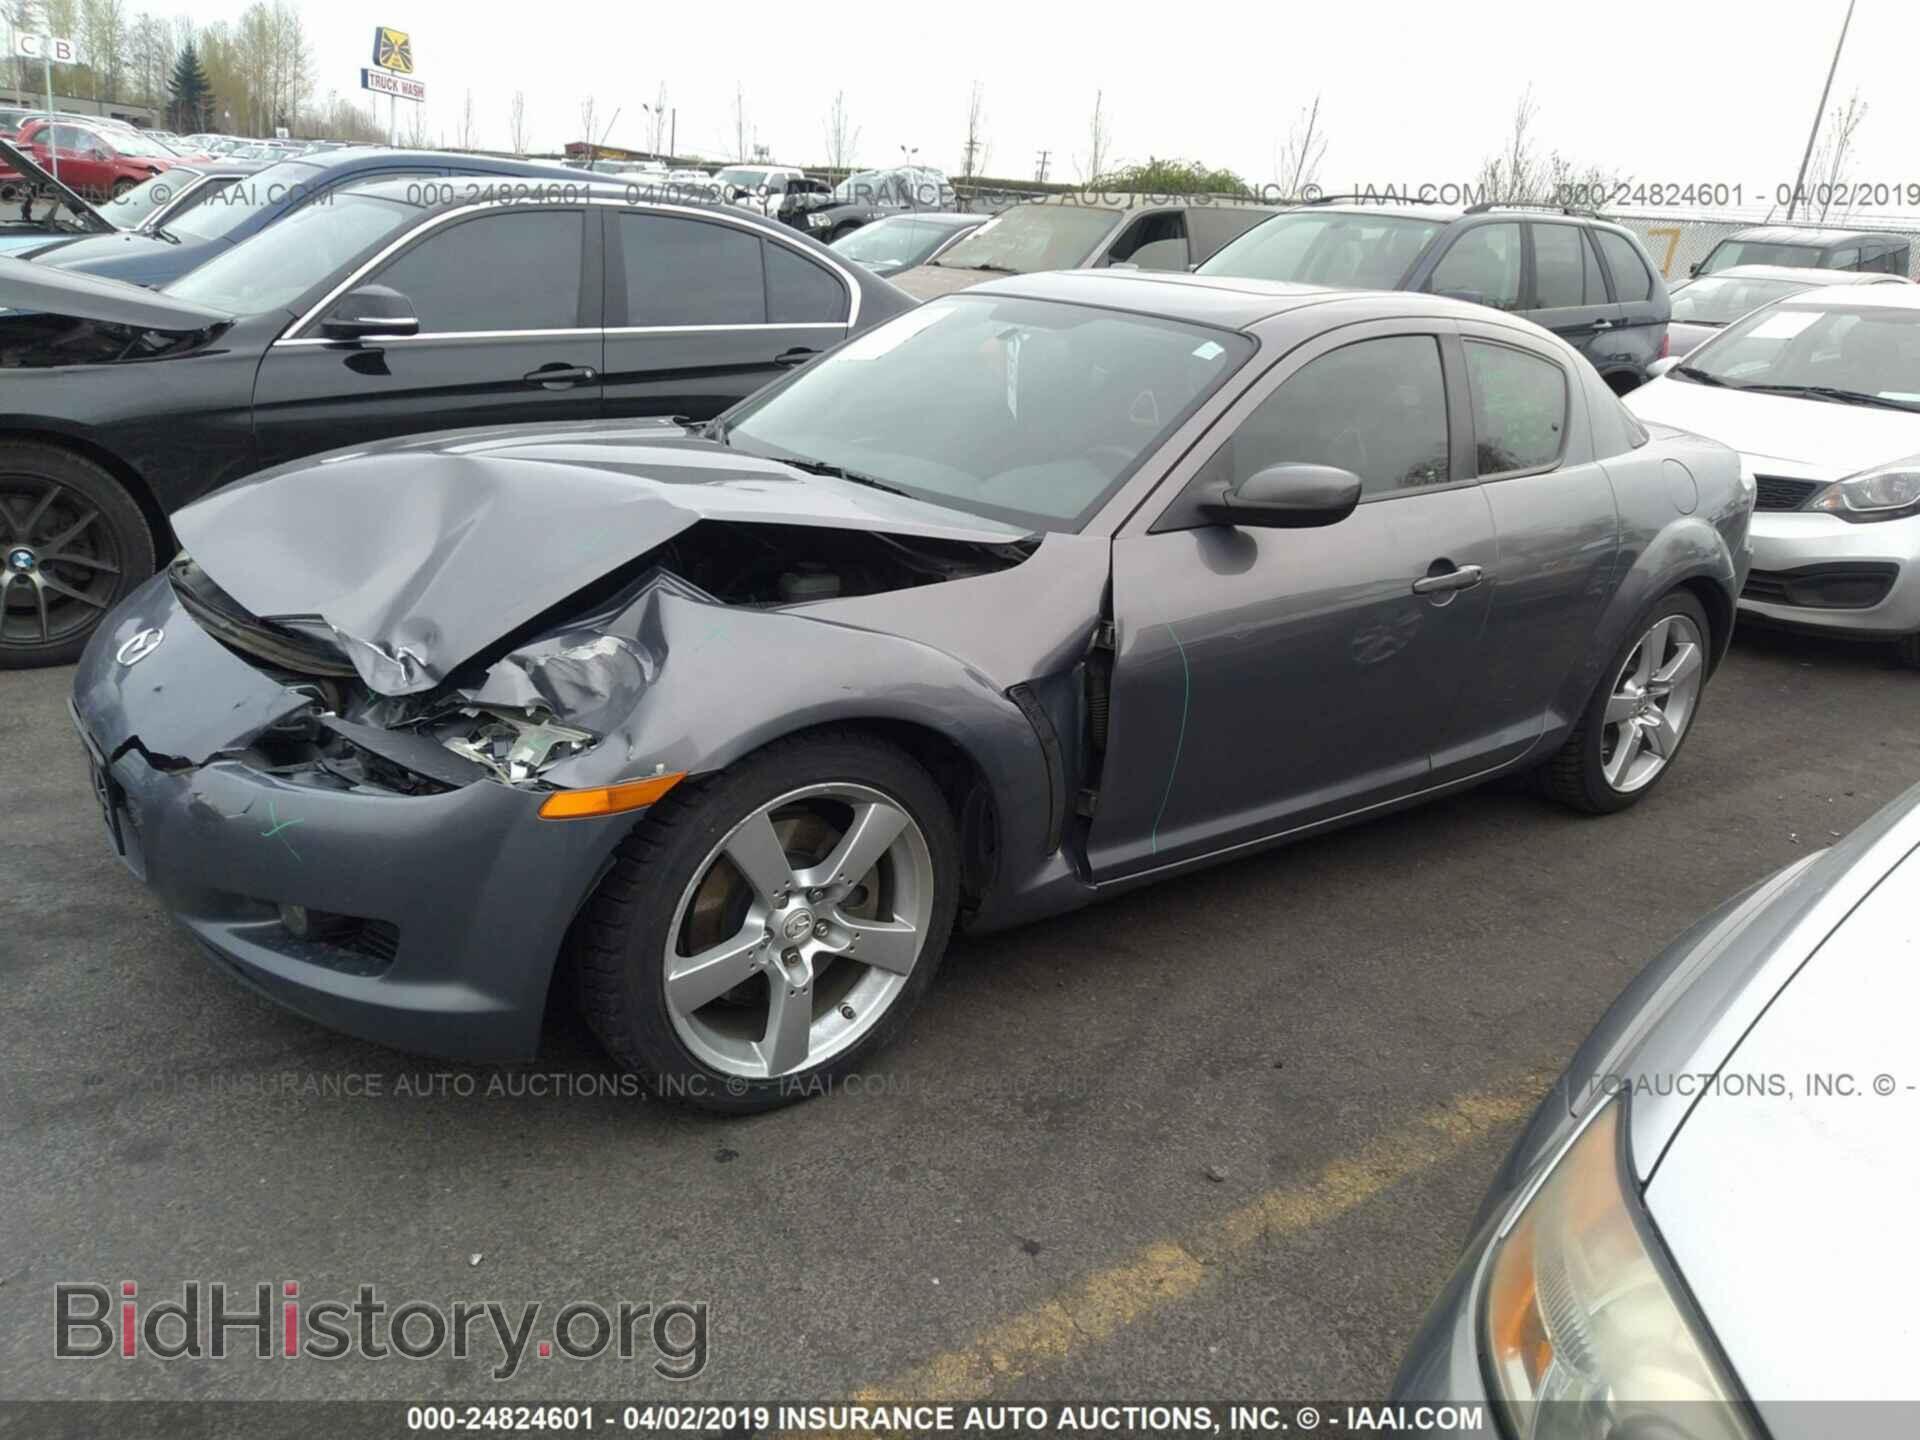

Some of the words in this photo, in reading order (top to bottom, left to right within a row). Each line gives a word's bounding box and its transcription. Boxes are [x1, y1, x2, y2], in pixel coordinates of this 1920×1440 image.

[20, 36, 35, 54] C
[56, 41, 71, 59] B
[369, 74, 398, 91] TRUCK
[402, 82, 424, 98] WASH
